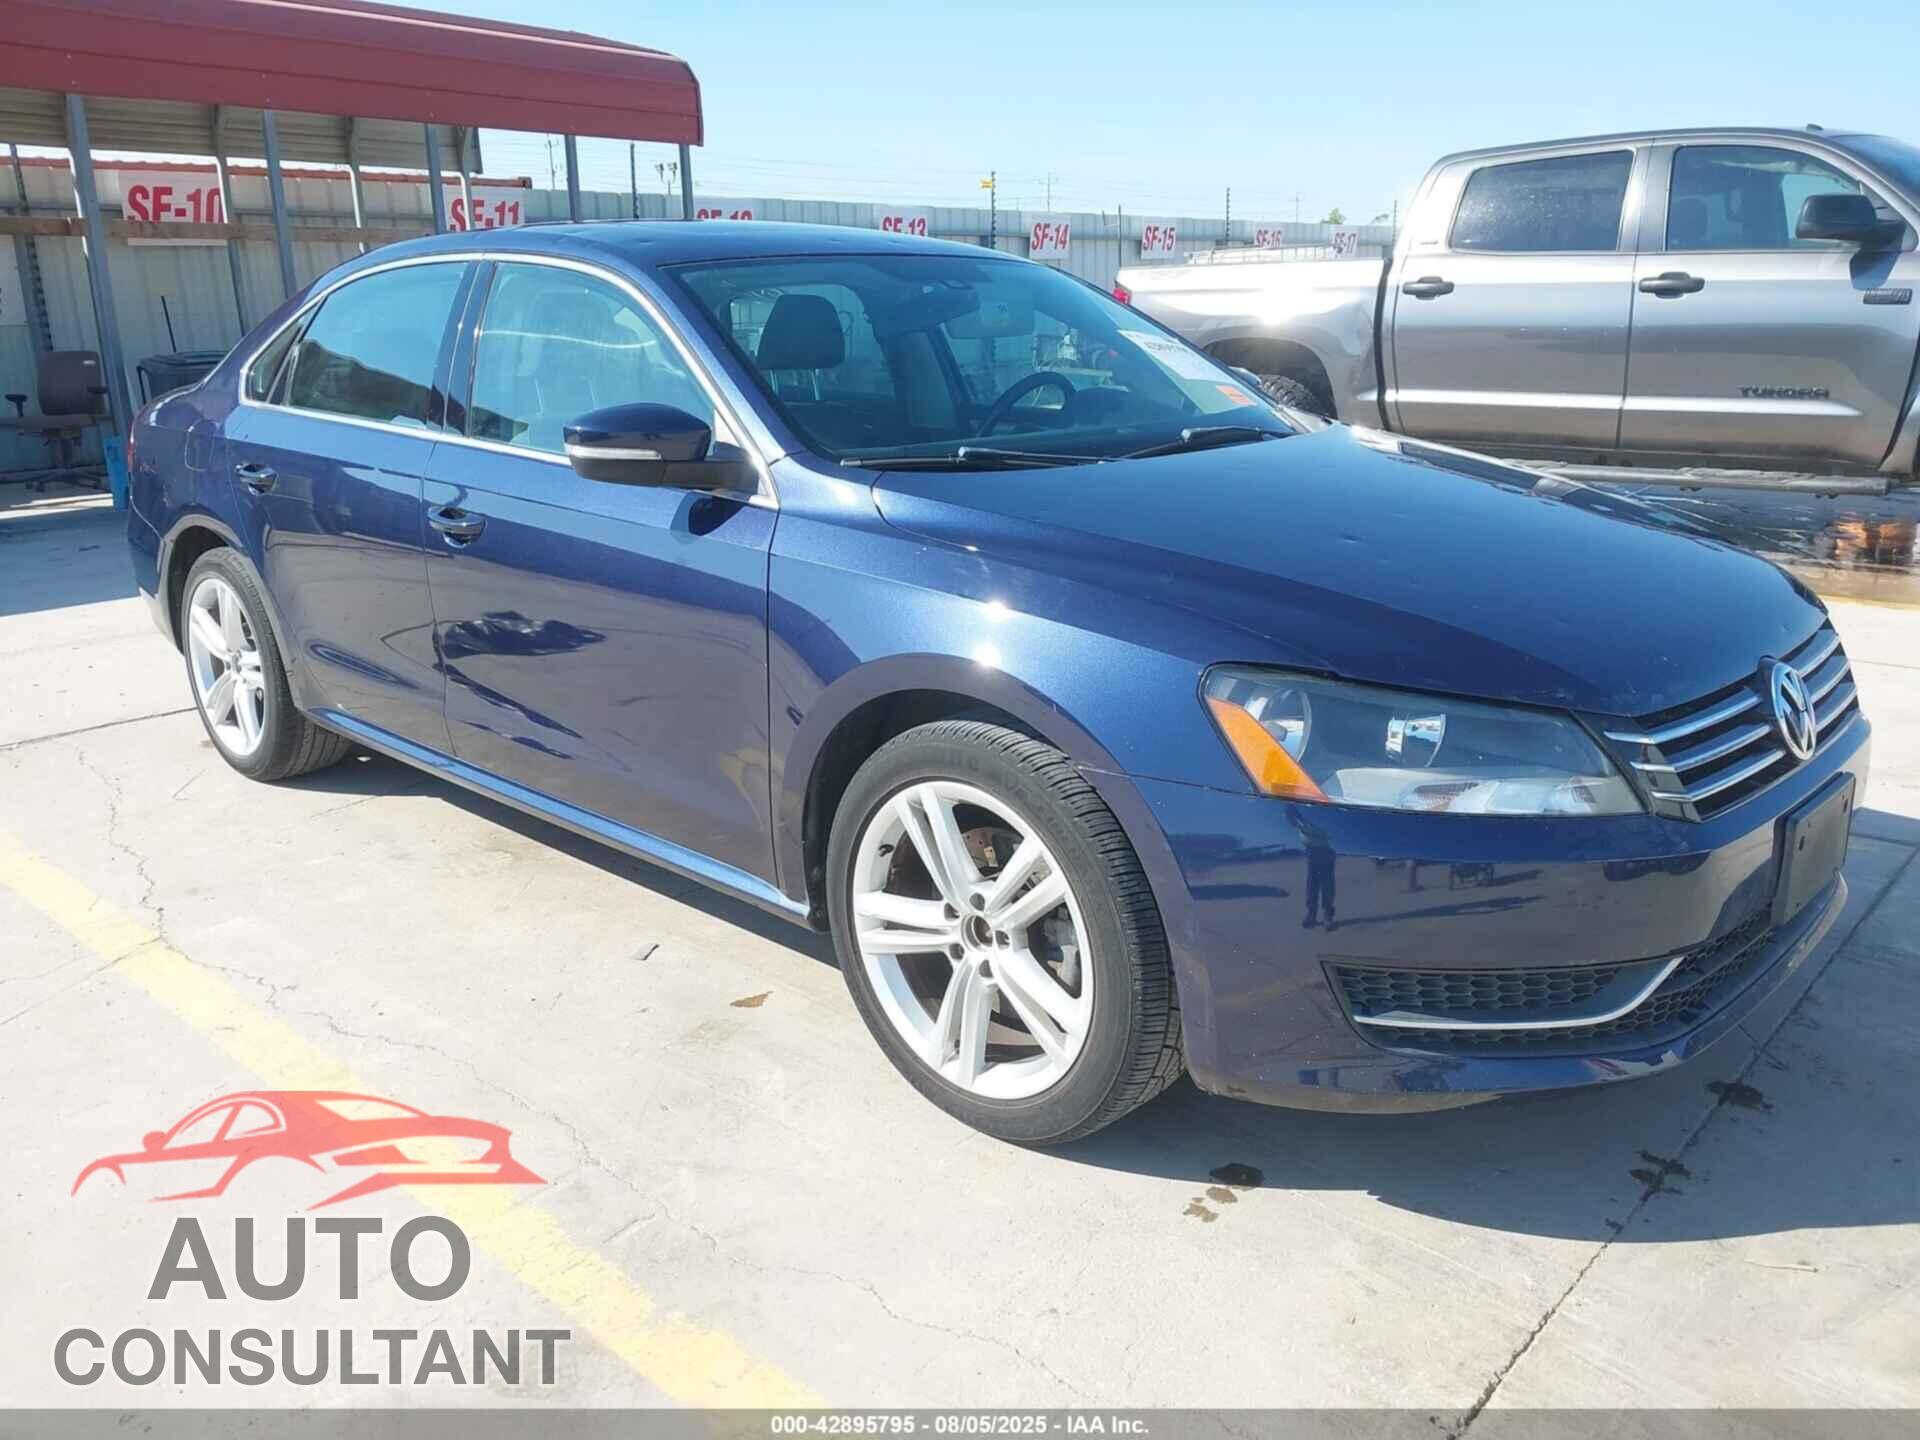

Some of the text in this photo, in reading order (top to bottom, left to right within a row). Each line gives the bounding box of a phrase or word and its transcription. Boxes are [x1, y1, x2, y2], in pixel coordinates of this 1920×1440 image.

[127, 185, 225, 224] SF-10
[882, 216, 927, 237] SF13
[1031, 222, 1069, 251] SF-14
[1142, 225, 1175, 250] SF-15
